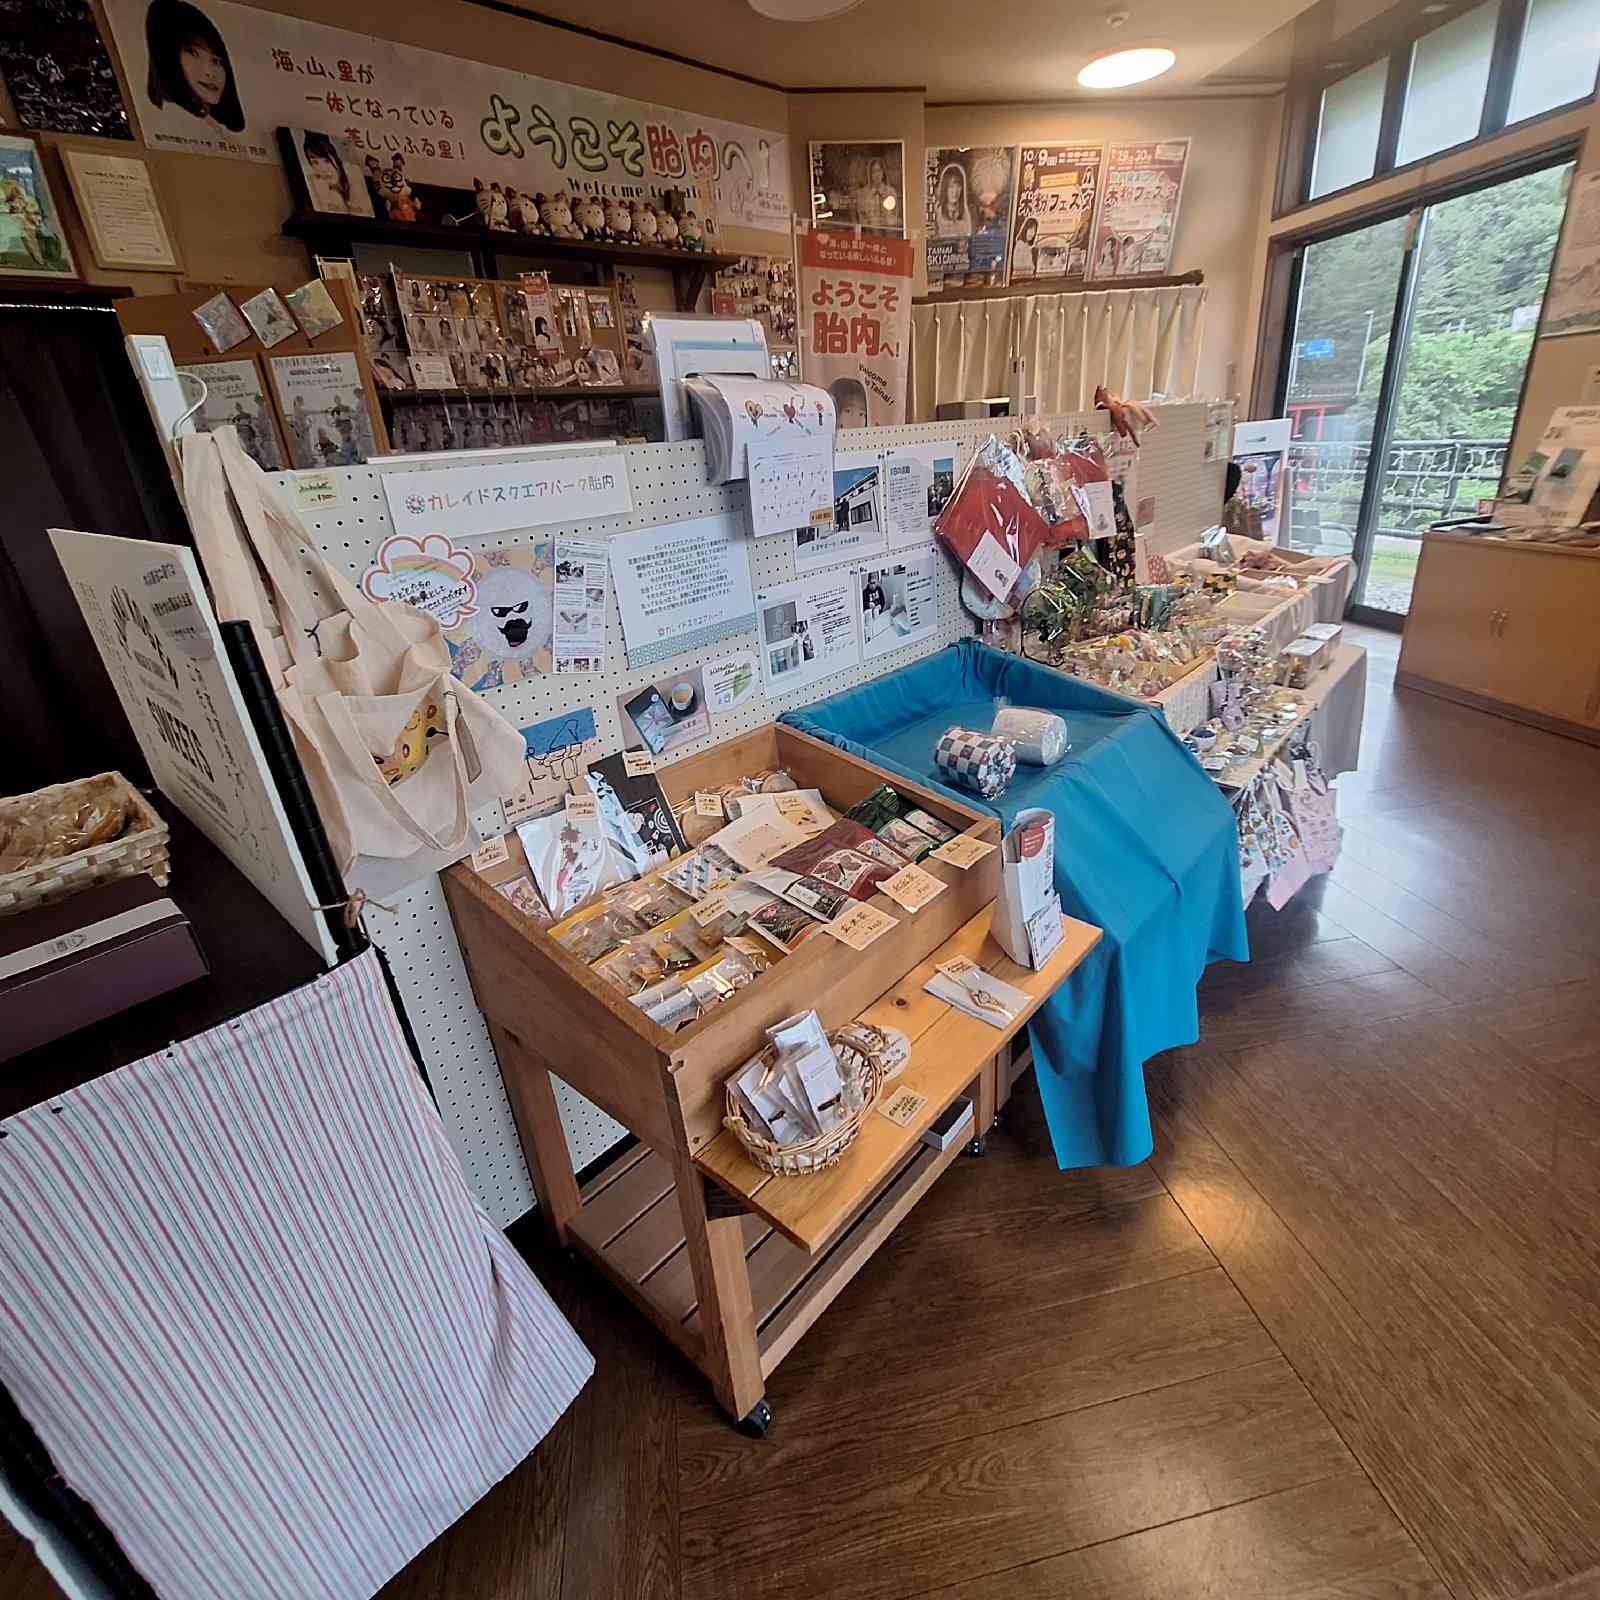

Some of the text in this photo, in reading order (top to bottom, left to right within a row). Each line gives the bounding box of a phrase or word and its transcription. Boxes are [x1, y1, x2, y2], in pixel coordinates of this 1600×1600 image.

[271, 47, 375, 85] 海、山、里が
[304, 92, 455, 129] 一体となっている
[567, 176, 644, 199] Welcome
[811, 279, 899, 312] ようこそ
[427, 473, 615, 511] カレイドスクエアパーク胎内
